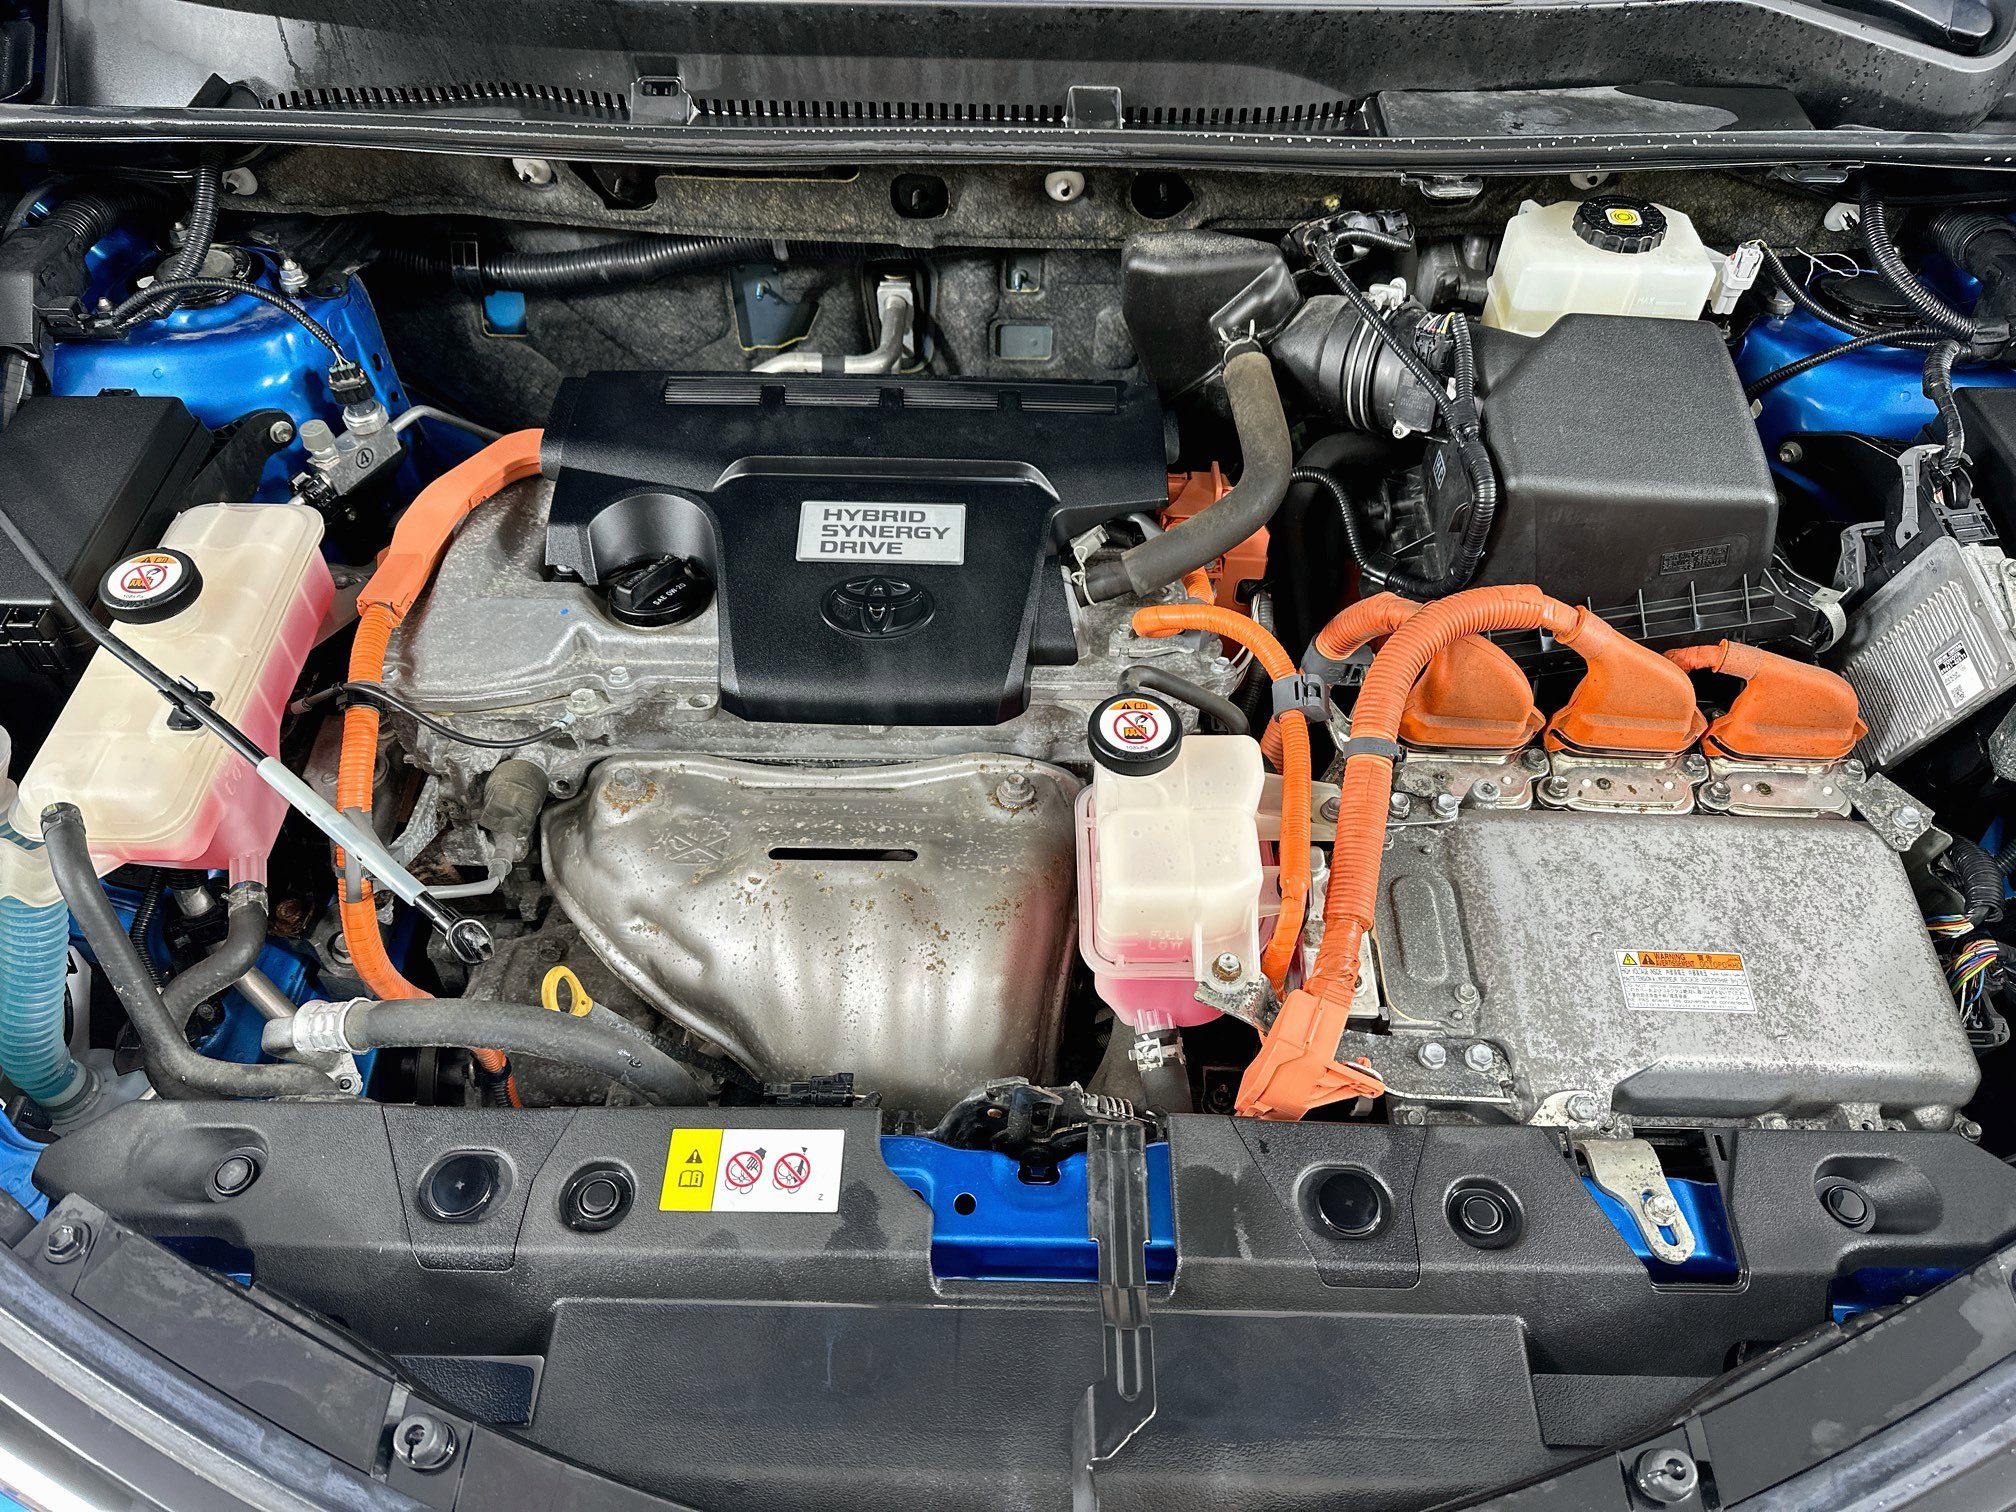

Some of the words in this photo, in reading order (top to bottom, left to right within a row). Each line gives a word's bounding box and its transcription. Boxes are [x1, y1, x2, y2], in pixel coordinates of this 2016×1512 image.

[824, 508, 926, 523] HYBRID
[821, 524, 951, 540] SYNERGY
[820, 540, 903, 555] DRIVE
[653, 594, 668, 606] SAE
[1653, 952, 1686, 961] WARNING
